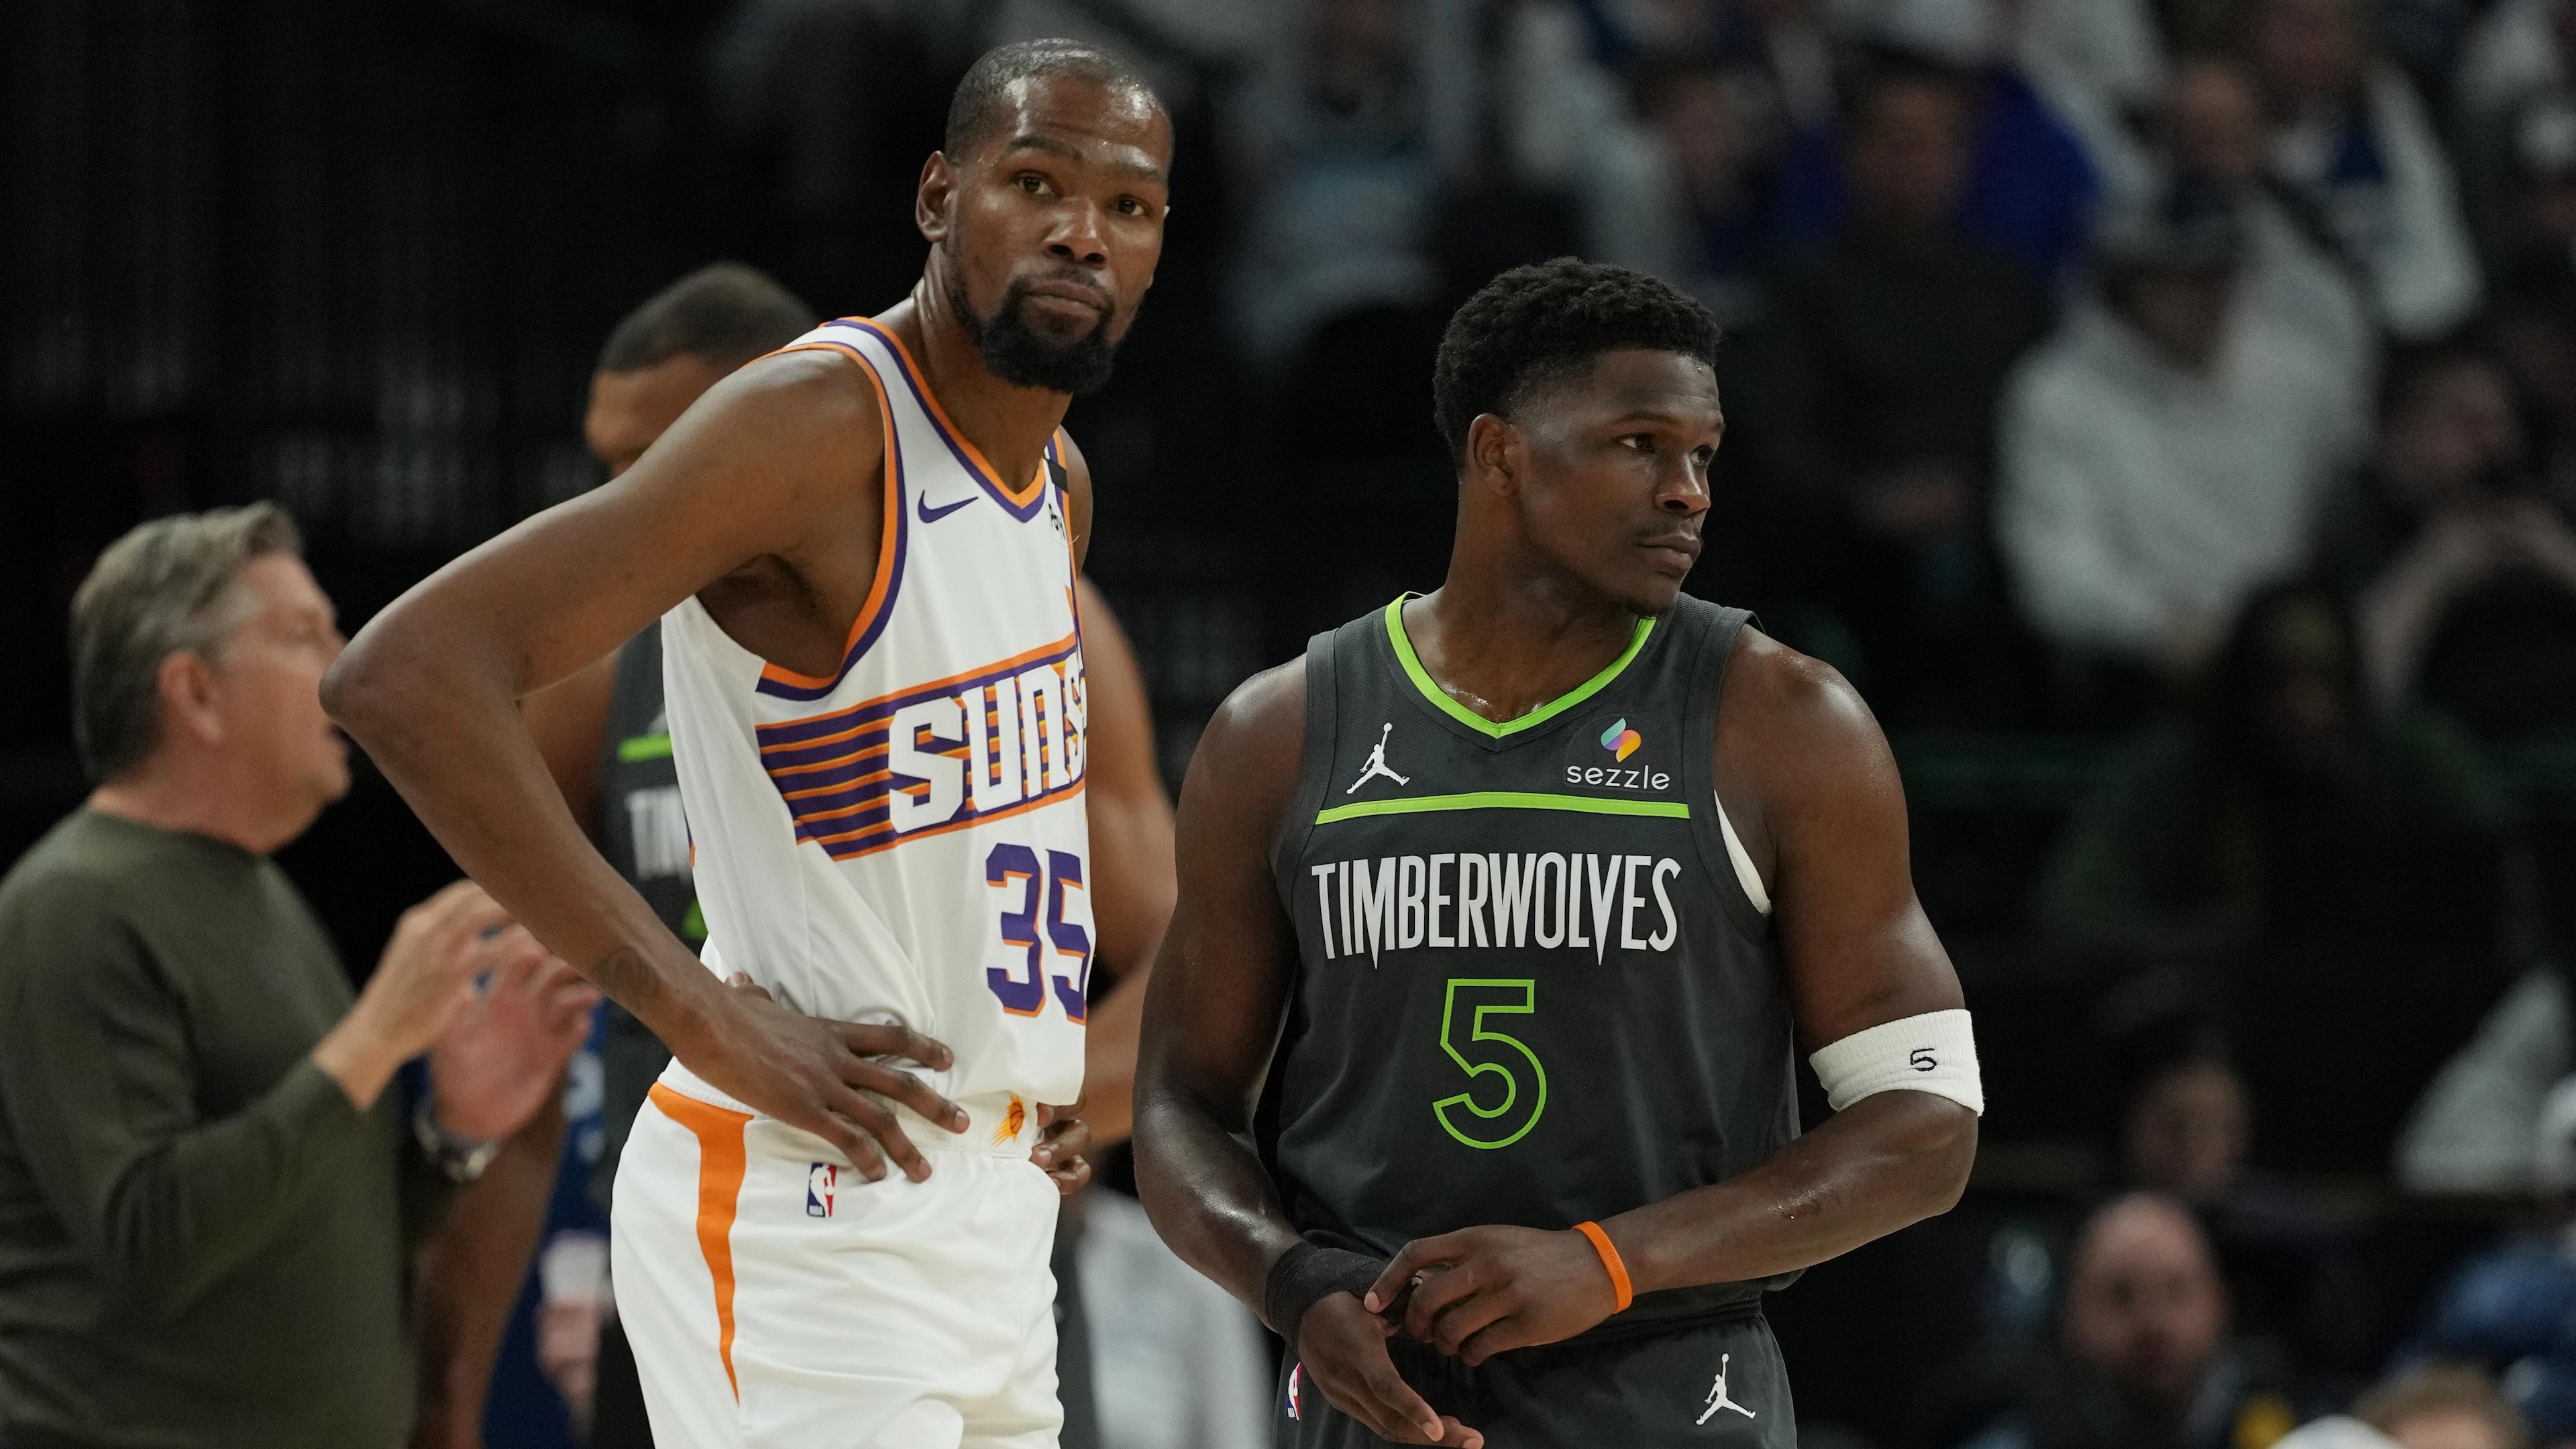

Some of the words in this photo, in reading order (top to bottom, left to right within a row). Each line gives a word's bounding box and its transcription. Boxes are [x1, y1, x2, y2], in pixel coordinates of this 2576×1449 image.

[1566, 765, 1670, 790] sezzle
[986, 843, 1090, 1026] 35
[1311, 852, 1681, 969] TIMBERWOLVES
[1432, 979, 1547, 1150] 5
[1910, 1048, 1937, 1071] 5
